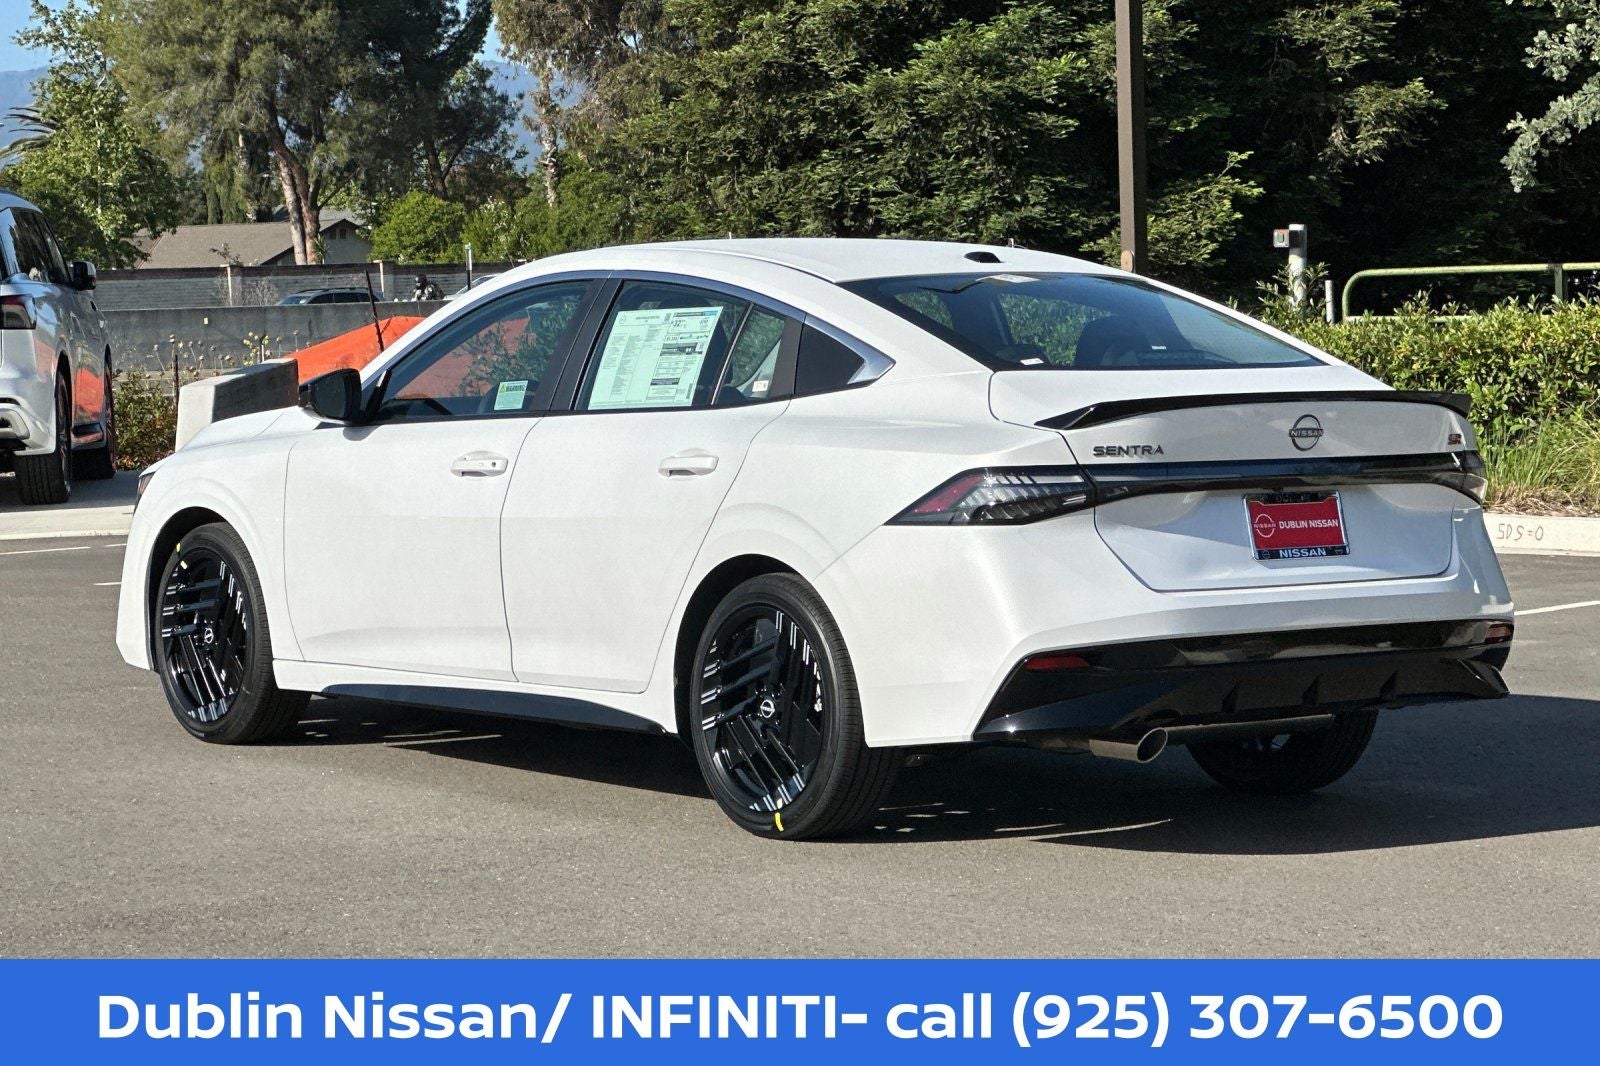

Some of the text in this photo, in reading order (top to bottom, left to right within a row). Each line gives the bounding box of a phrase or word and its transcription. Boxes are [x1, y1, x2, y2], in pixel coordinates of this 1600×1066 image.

[1290, 429, 1324, 438] NISSAN
[1093, 445, 1164, 456] SENTRA
[1279, 519, 1338, 529] DUBLIN NISSAN
[1279, 548, 1326, 558] NISSAN
